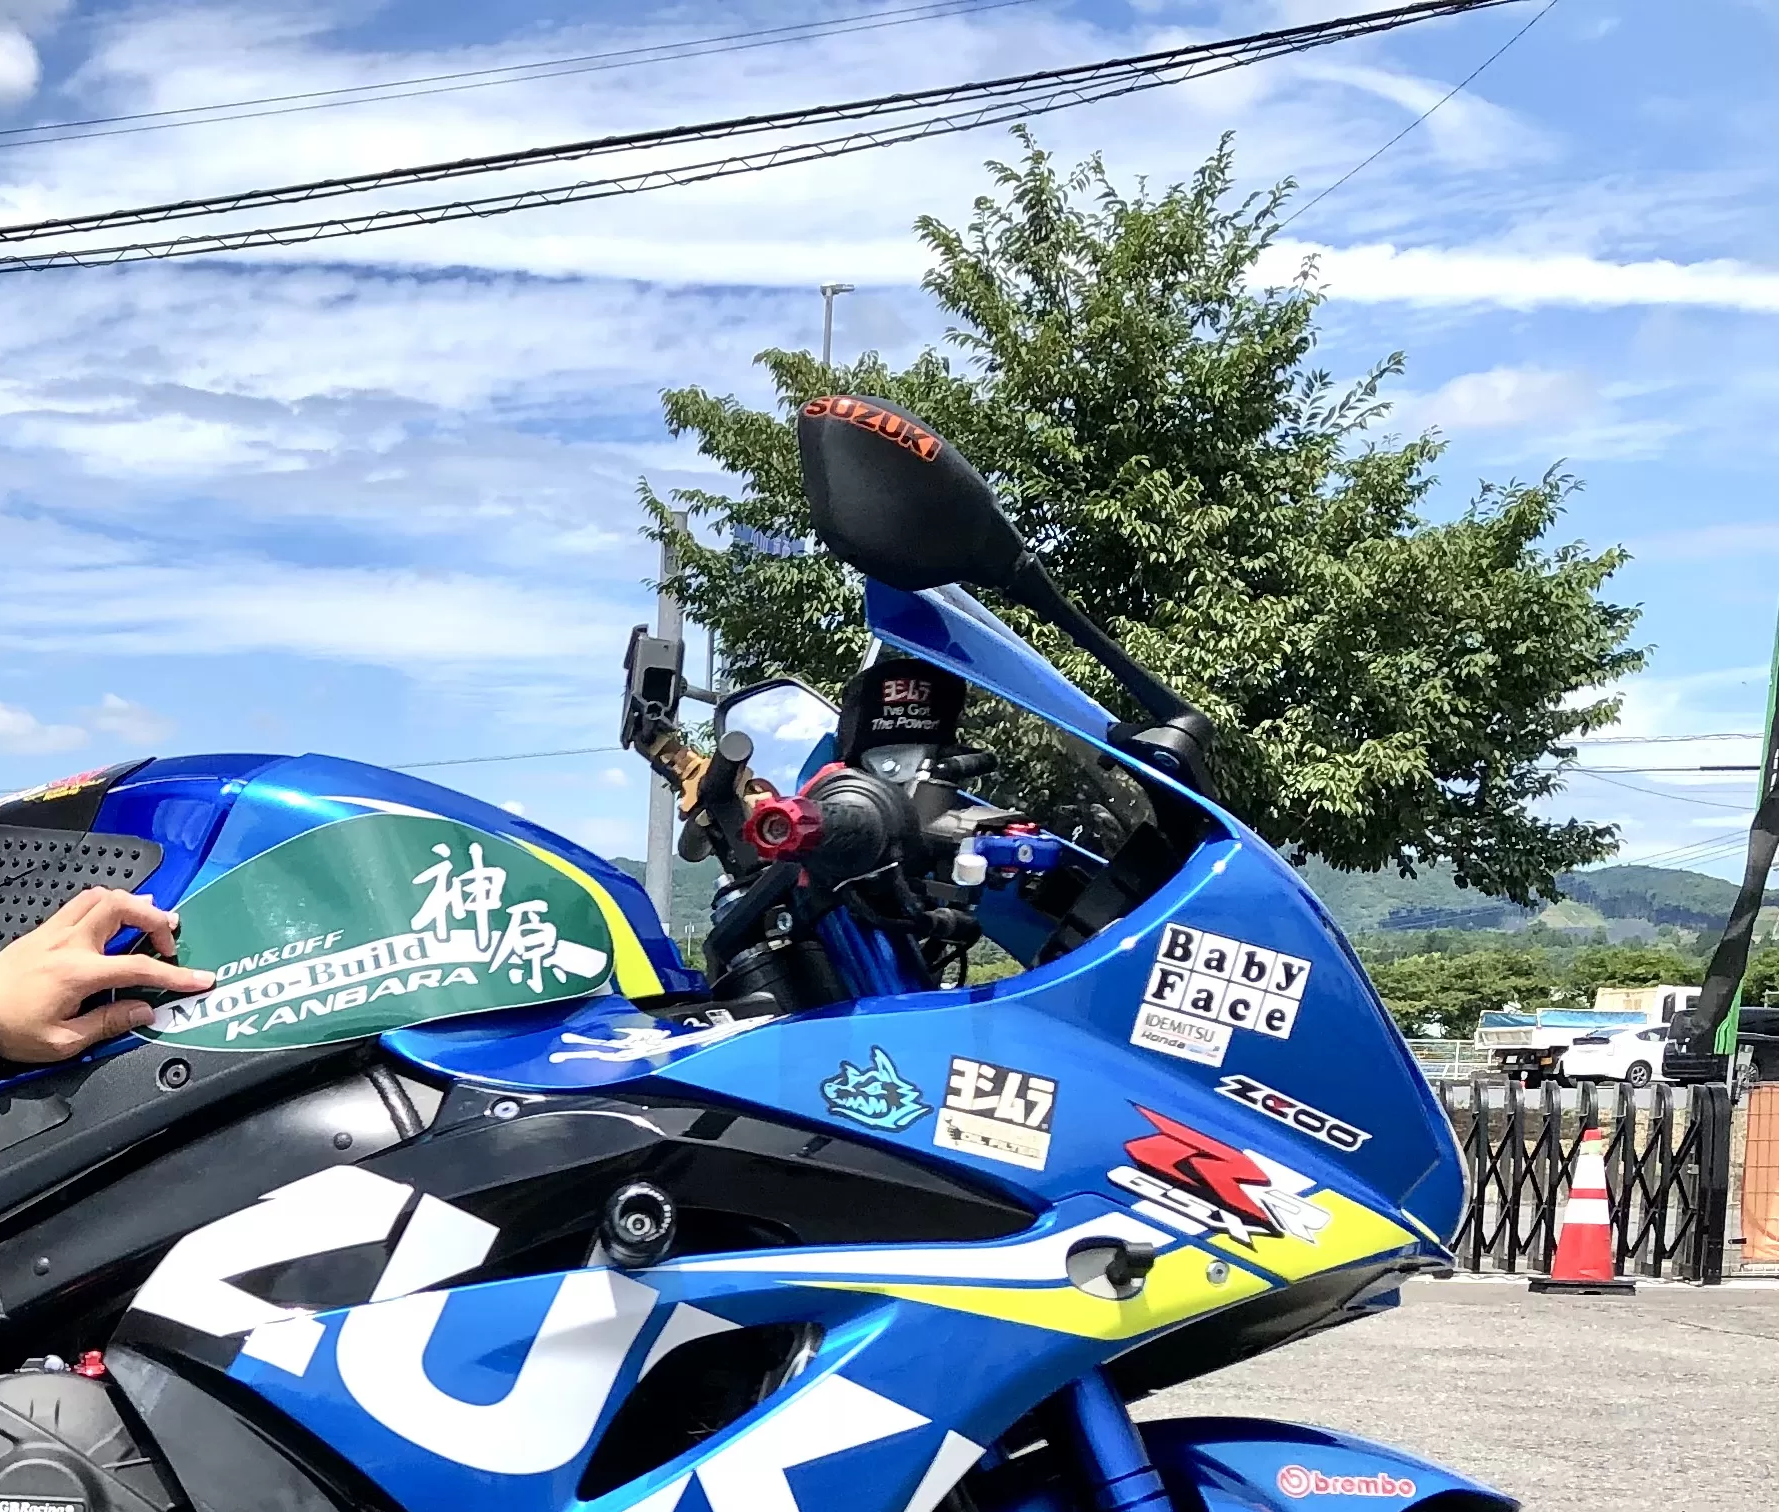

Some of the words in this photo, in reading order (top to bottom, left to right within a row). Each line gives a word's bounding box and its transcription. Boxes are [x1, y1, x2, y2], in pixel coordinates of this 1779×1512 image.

[803, 396, 942, 462] SUZUKI
[883, 679, 931, 702] ヨシムラ
[907, 703, 931, 716] Got
[871, 717, 894, 730] The
[410, 842, 569, 993] 神原
[167, 936, 433, 1029] Moto-Build
[216, 929, 345, 982] ON&OFF
[1162, 926, 1306, 991] Baby
[225, 967, 480, 1042] KANBARA
[1144, 1012, 1217, 1043] IDEMITSU
[1151, 967, 1286, 1032] Face
[1140, 1030, 1186, 1049] Honda
[945, 1058, 1055, 1128] ヨシムラ
[1312, 1472, 1415, 1498] brembo
